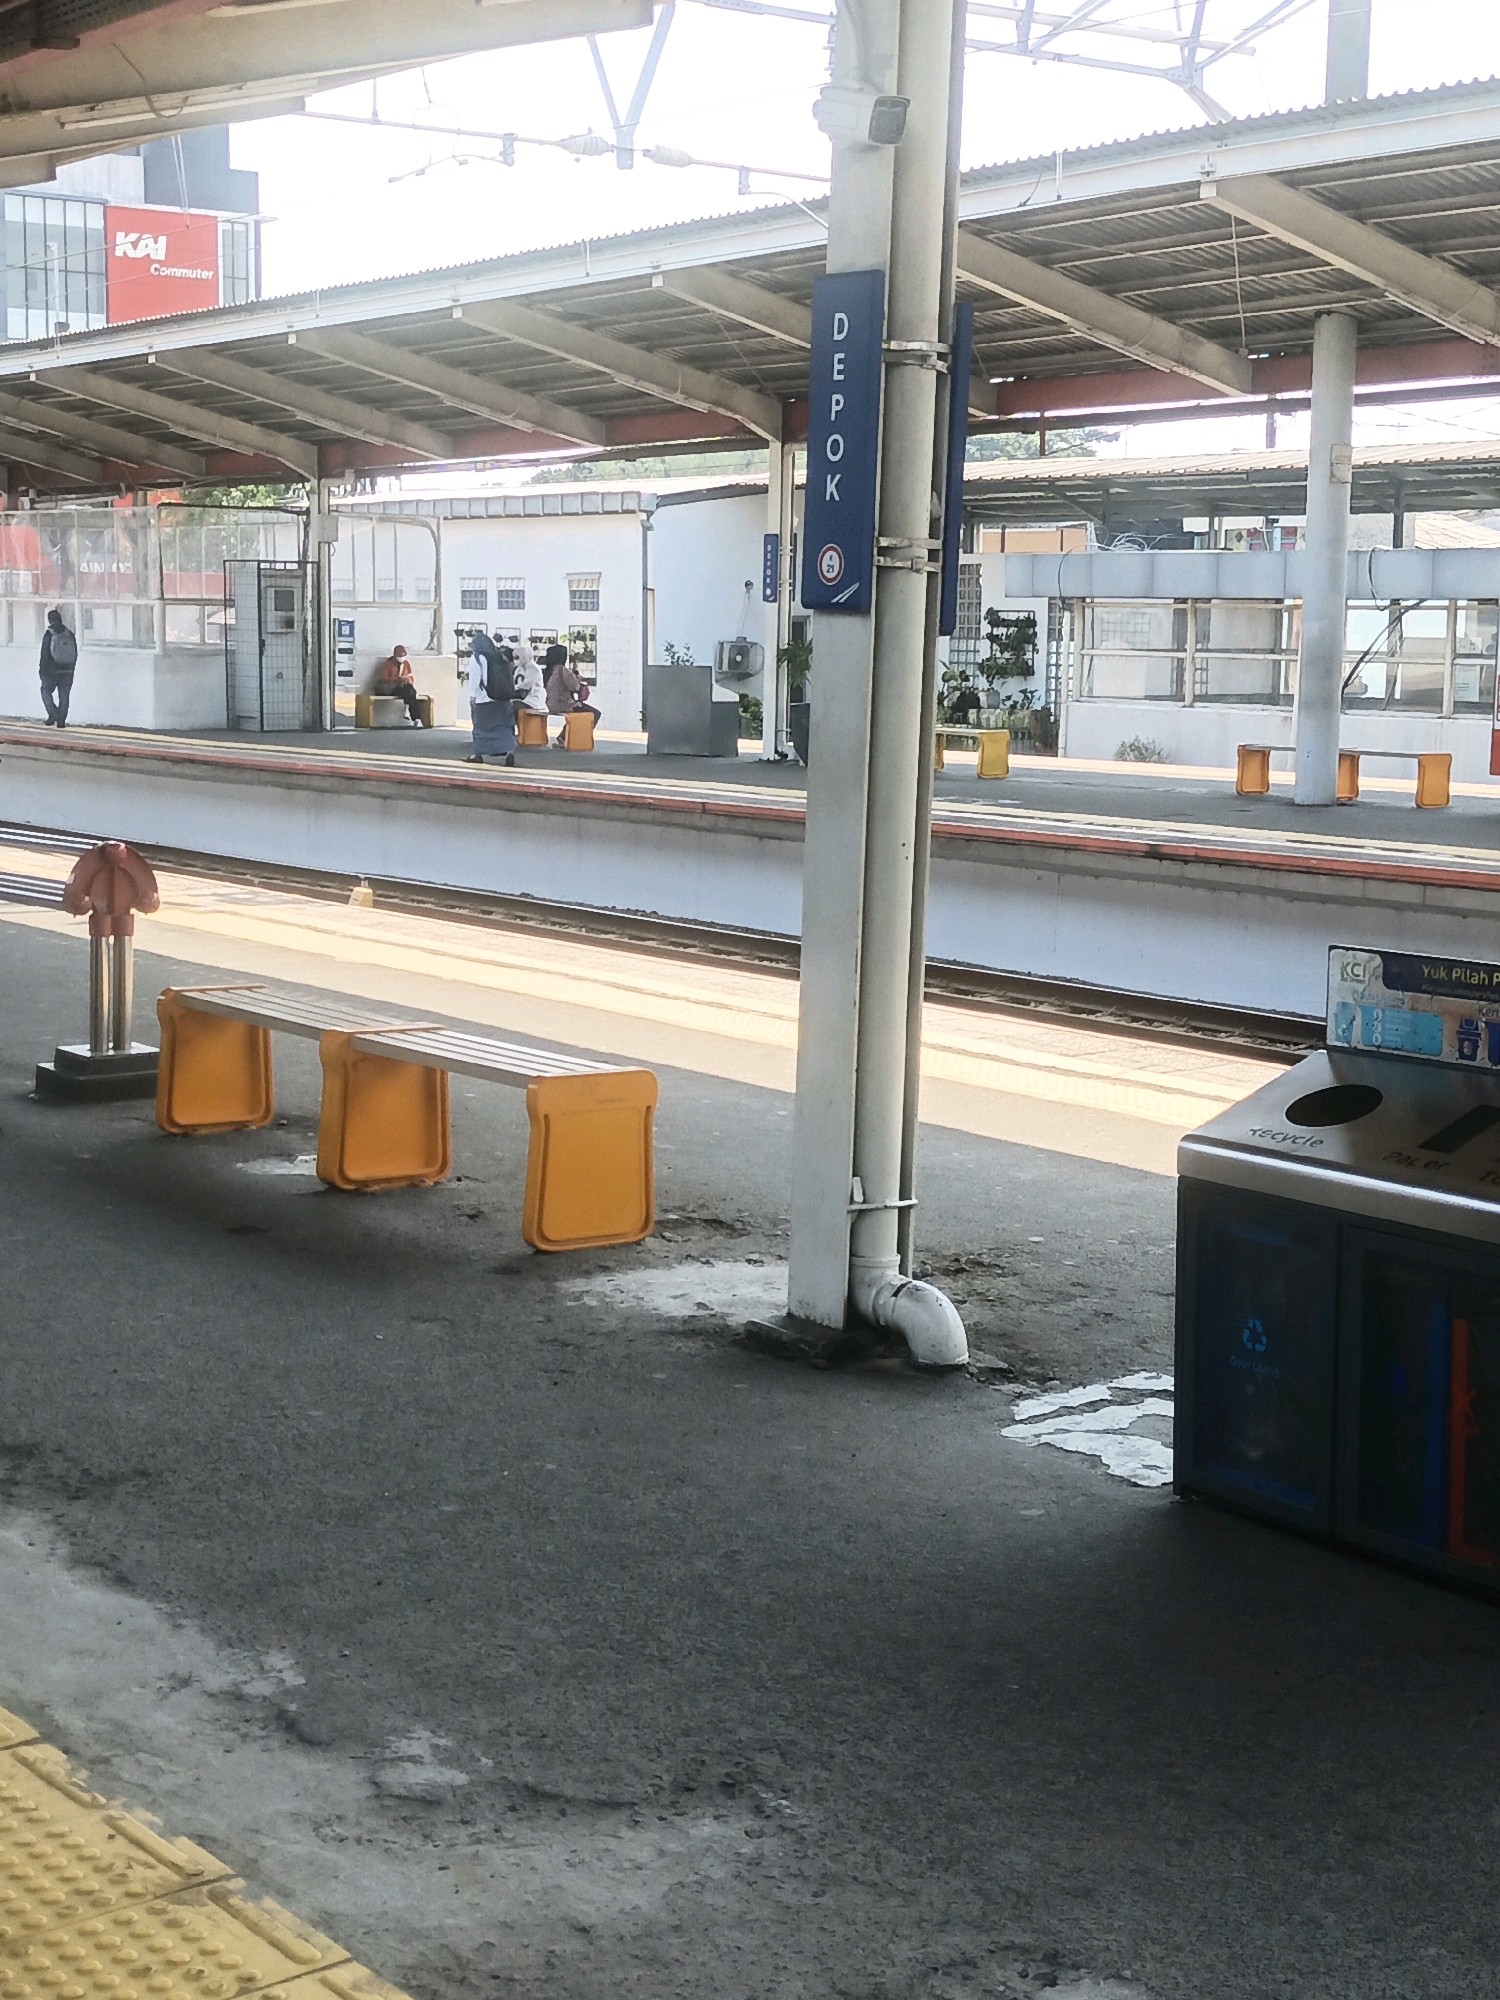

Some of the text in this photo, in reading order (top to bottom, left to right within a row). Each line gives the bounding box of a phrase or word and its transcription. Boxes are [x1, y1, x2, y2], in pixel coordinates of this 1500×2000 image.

[114, 231, 168, 261] KAI
[150, 263, 215, 280] Commuter
[825, 312, 850, 502] DEPOK
[1340, 960, 1367, 979] KCI
[1421, 963, 1449, 981] Yuk
[1451, 967, 1489, 986] Pilah
